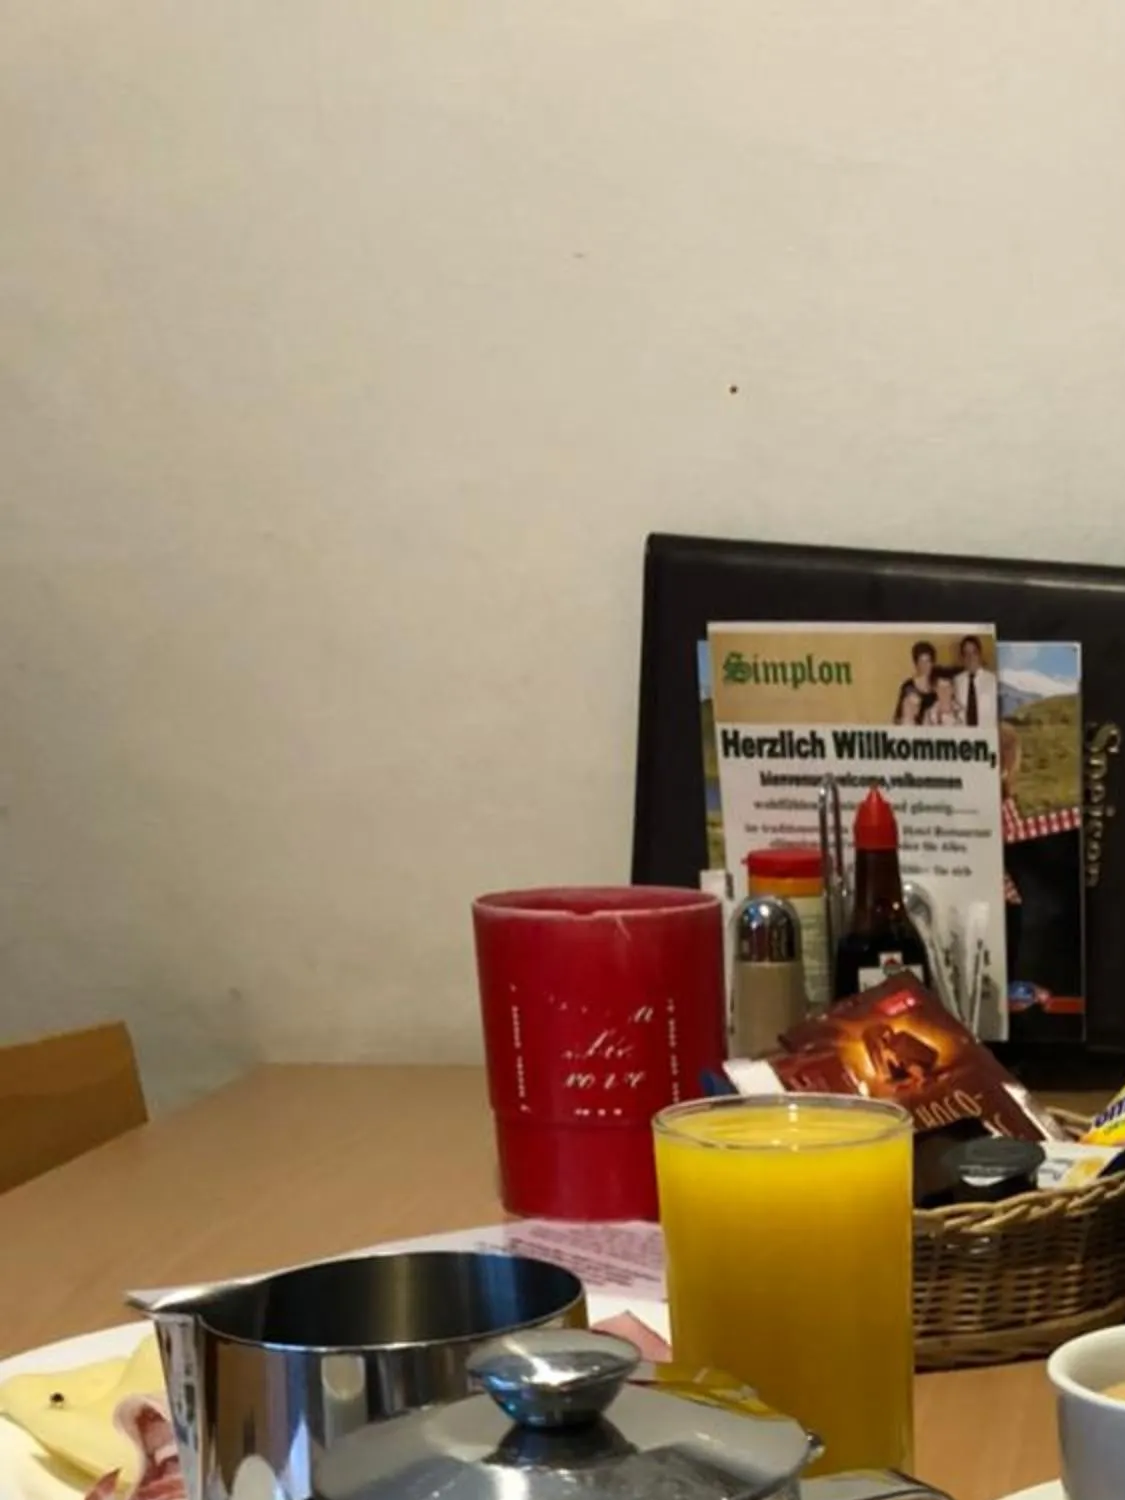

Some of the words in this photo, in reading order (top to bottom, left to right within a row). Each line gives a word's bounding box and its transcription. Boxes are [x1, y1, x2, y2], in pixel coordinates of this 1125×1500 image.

[723, 652, 852, 689] Simplon
[721, 729, 826, 759] Herzlich
[832, 731, 997, 768] Willkommen,
